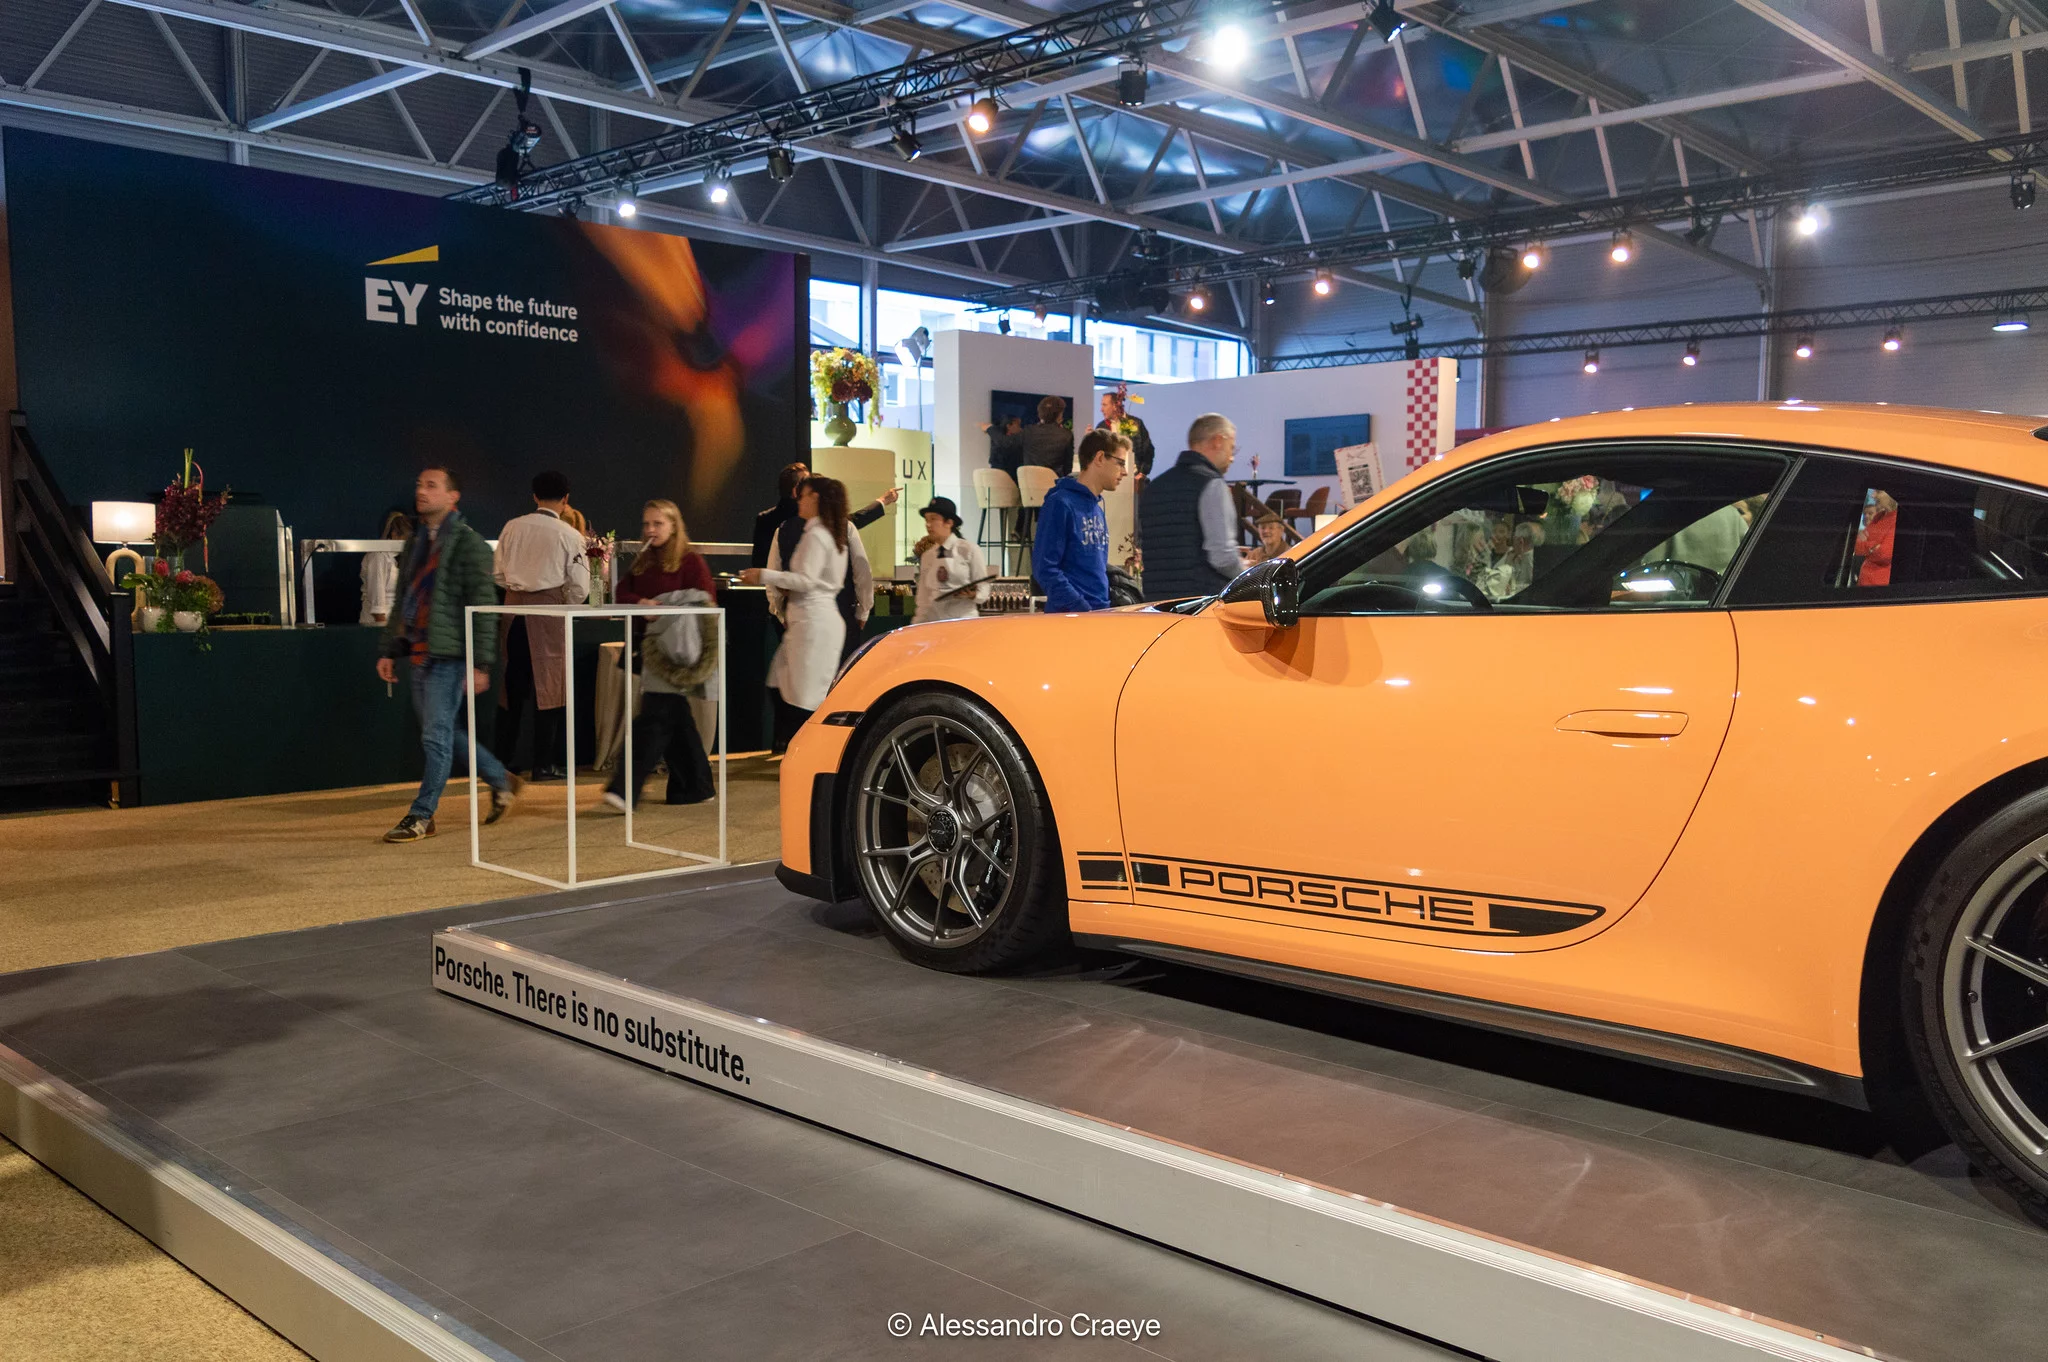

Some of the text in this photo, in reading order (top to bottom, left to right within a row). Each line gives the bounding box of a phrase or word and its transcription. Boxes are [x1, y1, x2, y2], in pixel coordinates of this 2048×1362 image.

[365, 277, 429, 326] EY
[439, 287, 578, 320] Shape the future
[440, 312, 579, 343] with confidence
[1180, 866, 1475, 926] PORSCHE
[435, 945, 751, 1085] Porsche. There is no substitute.
